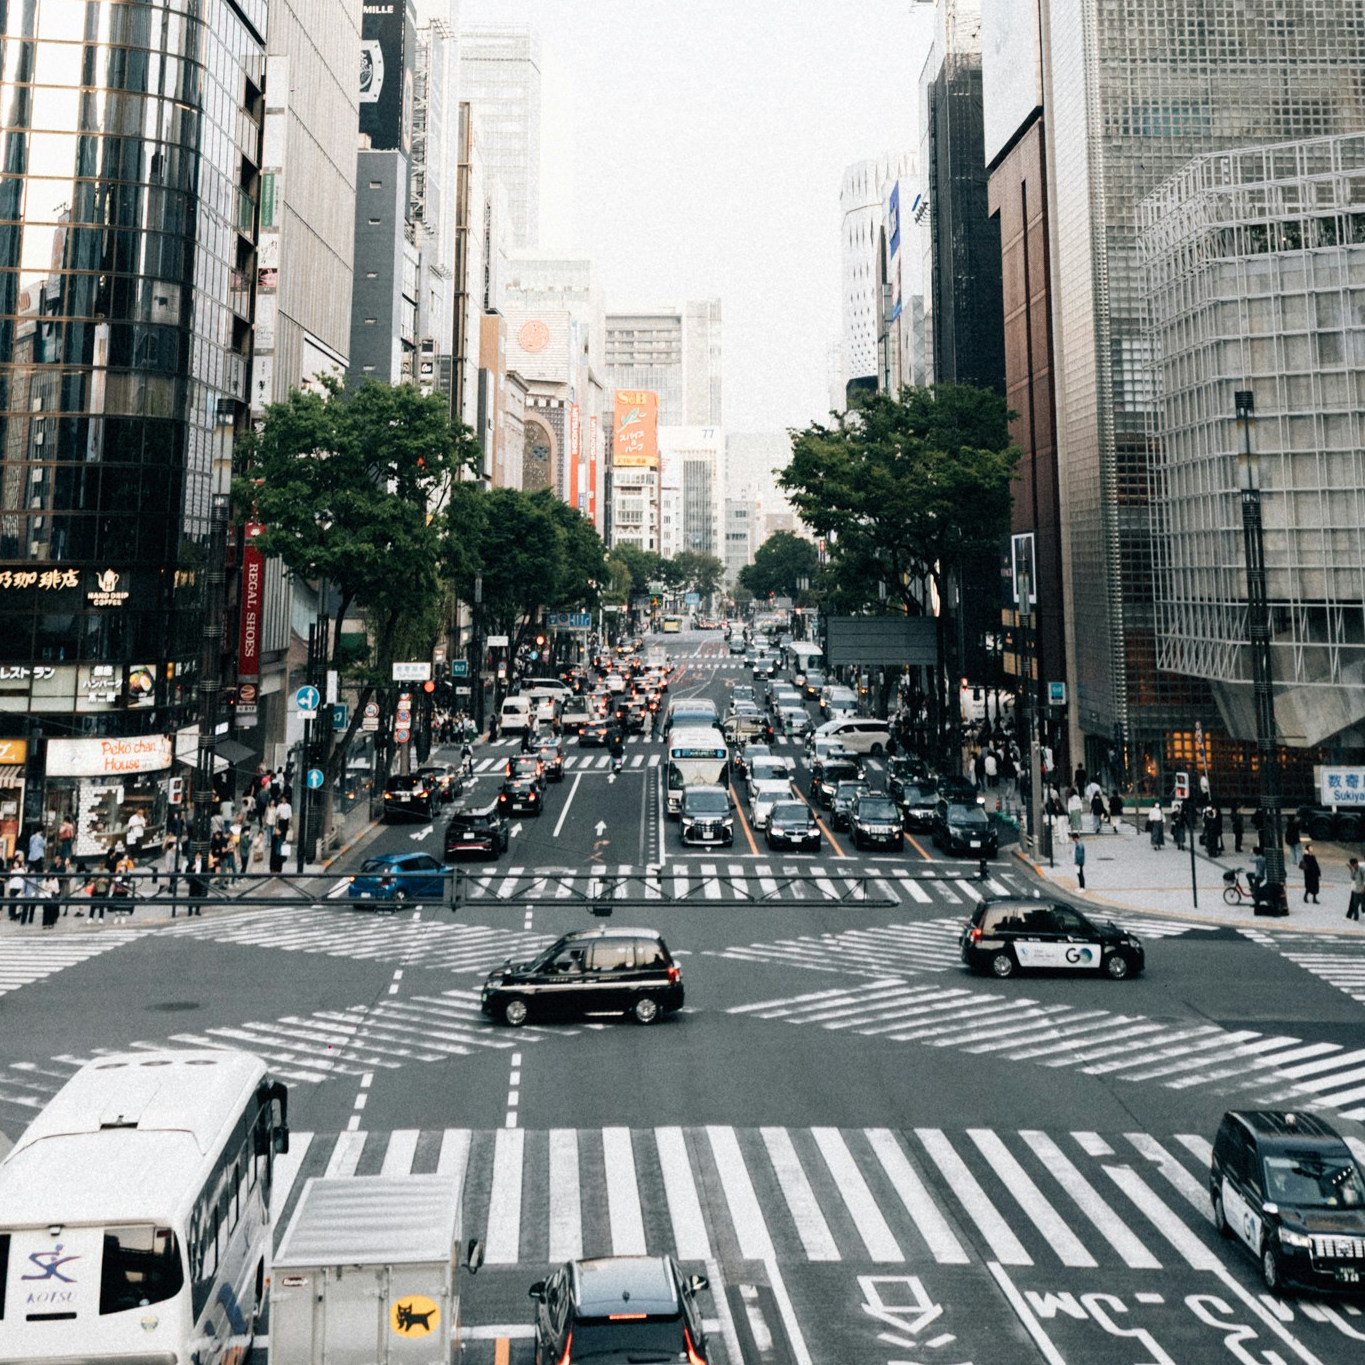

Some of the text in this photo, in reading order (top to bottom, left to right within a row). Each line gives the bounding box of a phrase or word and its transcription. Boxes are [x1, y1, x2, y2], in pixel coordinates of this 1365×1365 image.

[363, 5, 394, 14] MILLE
[244, 563, 259, 658] REGAL SHOES
[82, 679, 123, 689] ハンバーグ
[87, 691, 117, 703] 不二家
[101, 739, 157, 756] Peko chan
[104, 757, 140, 772] House
[26, 1291, 78, 1304] KOTSU
